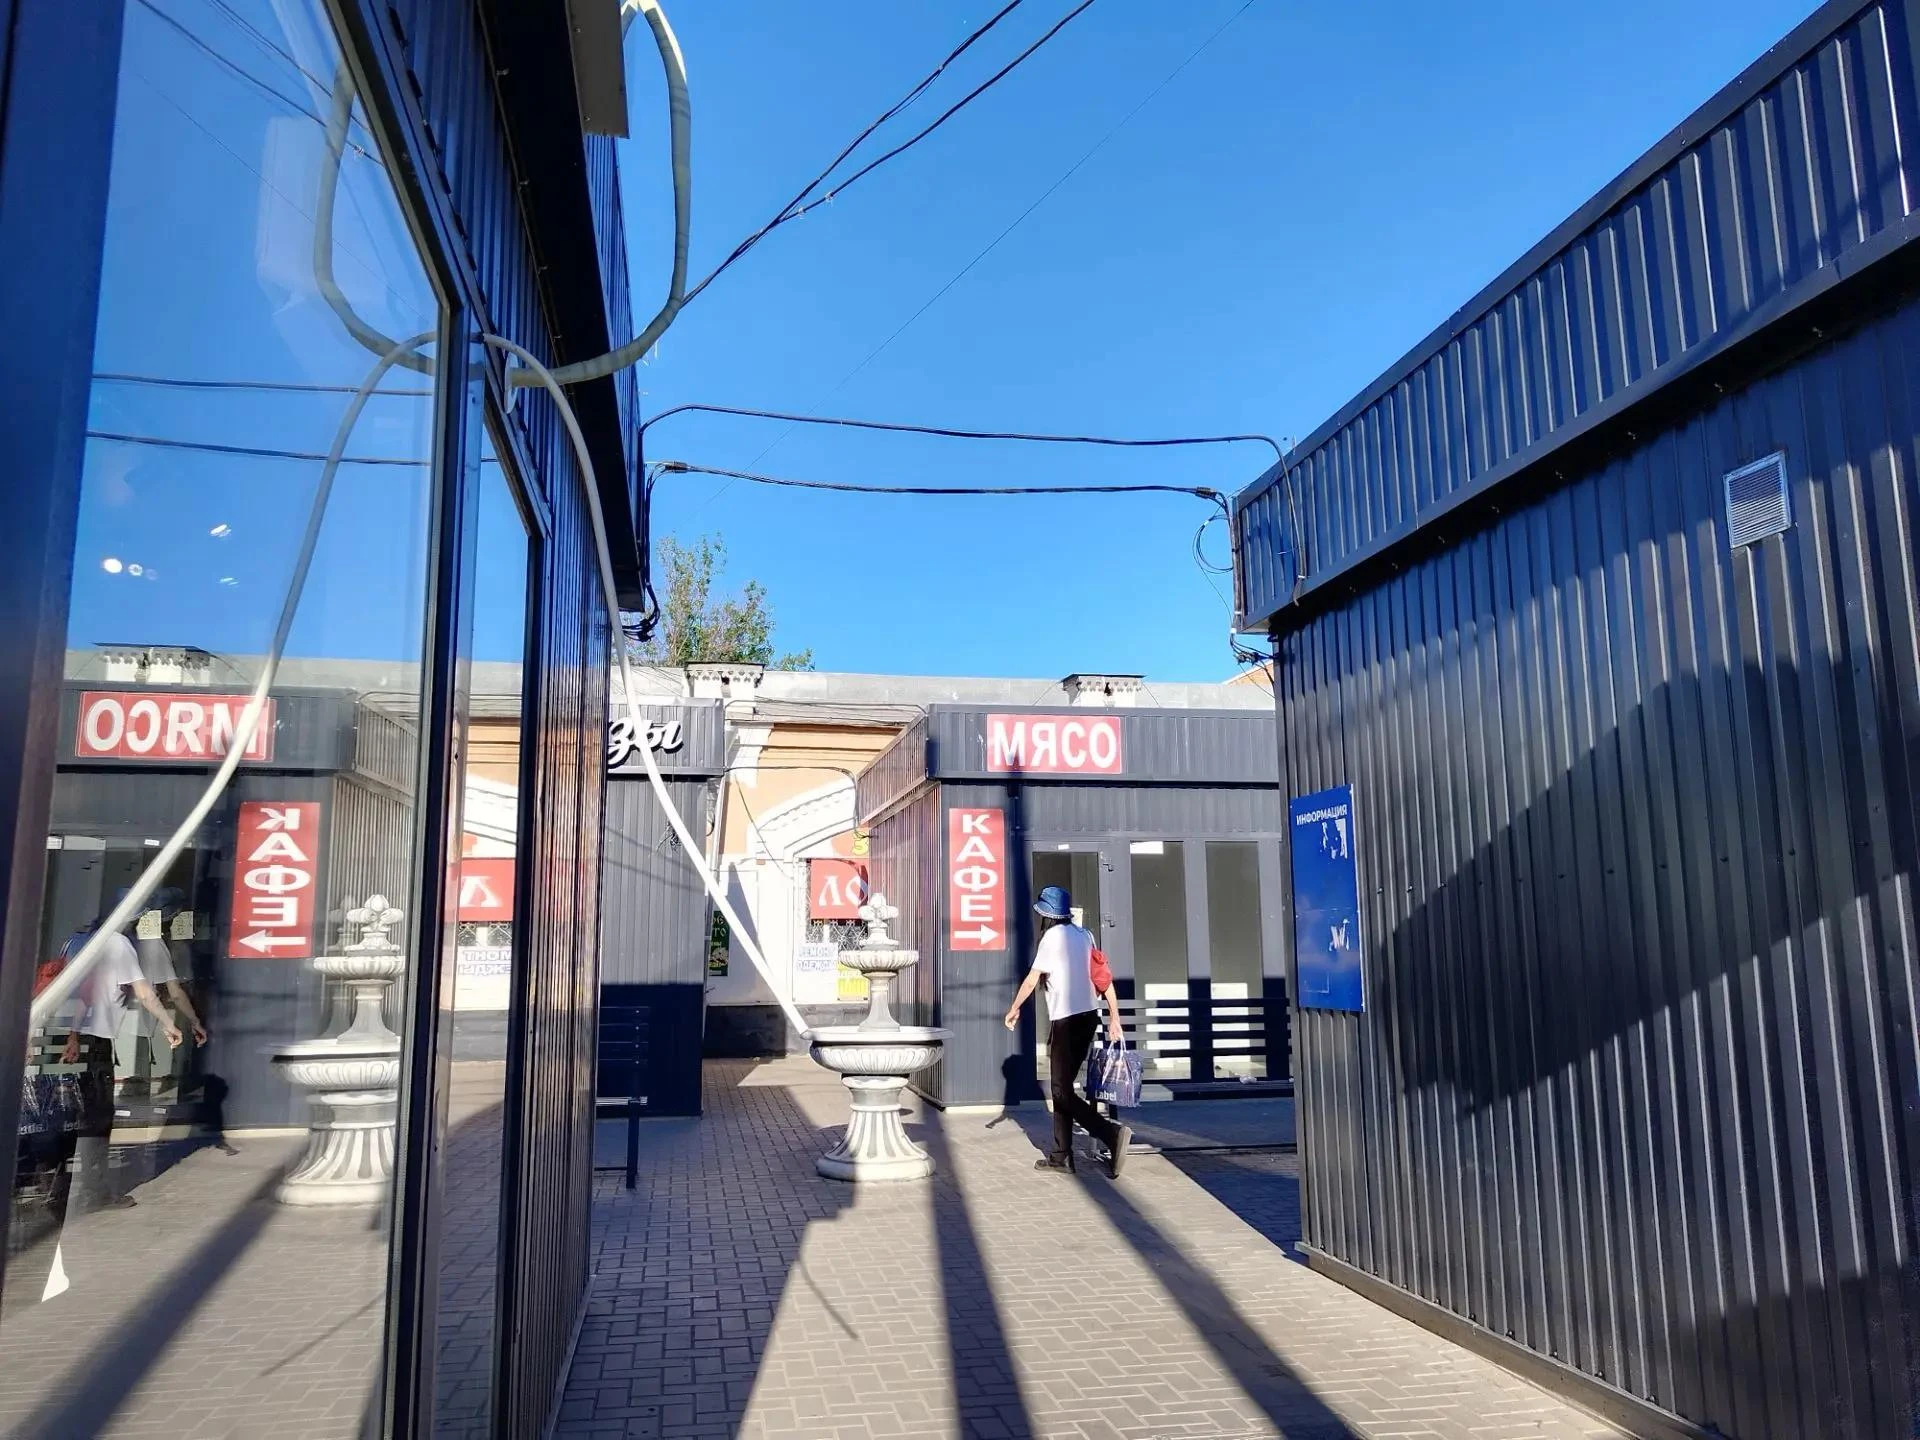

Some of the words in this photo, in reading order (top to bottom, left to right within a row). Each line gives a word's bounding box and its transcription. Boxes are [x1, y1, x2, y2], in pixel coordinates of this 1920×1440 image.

[992, 720, 1118, 769] МЯСО
[1296, 804, 1348, 826] ИНФОРМАЦИЯ
[953, 813, 999, 923] КАФЕ
[1095, 1090, 1117, 1101] Label
